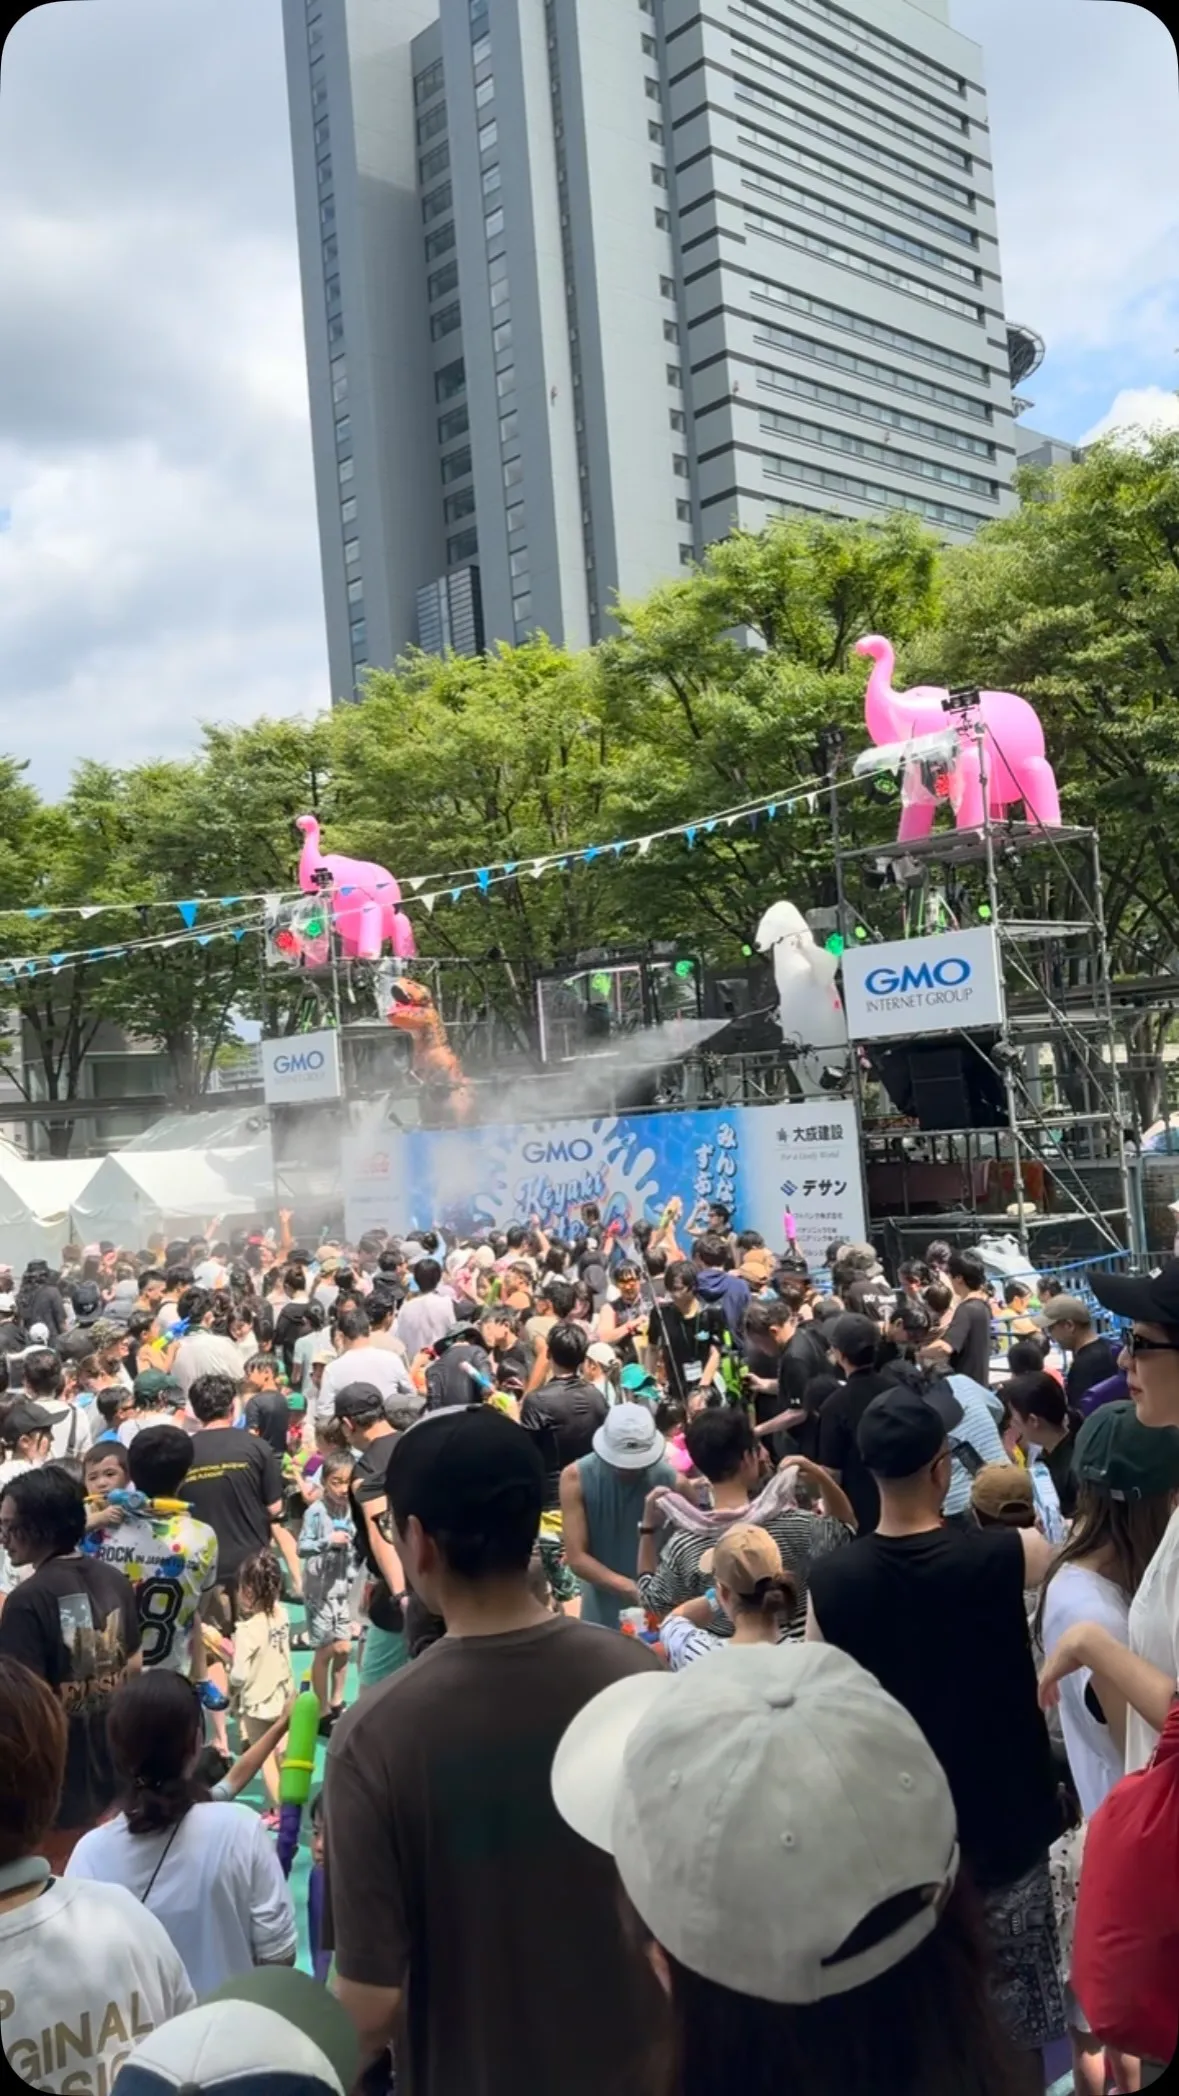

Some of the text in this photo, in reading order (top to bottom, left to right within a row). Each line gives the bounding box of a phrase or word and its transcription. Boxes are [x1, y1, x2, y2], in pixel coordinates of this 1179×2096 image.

[865, 958, 971, 996] GMO
[866, 987, 974, 1012] INTERNET GROUP
[273, 1050, 325, 1074] GMO
[793, 1124, 844, 1142] 大成建設
[522, 1137, 594, 1164] GMO
[513, 1168, 607, 1218] Keyaki
[803, 1179, 848, 1197] デサン
[96, 1546, 135, 1563] ROCK
[136, 1575, 184, 1667] 8
